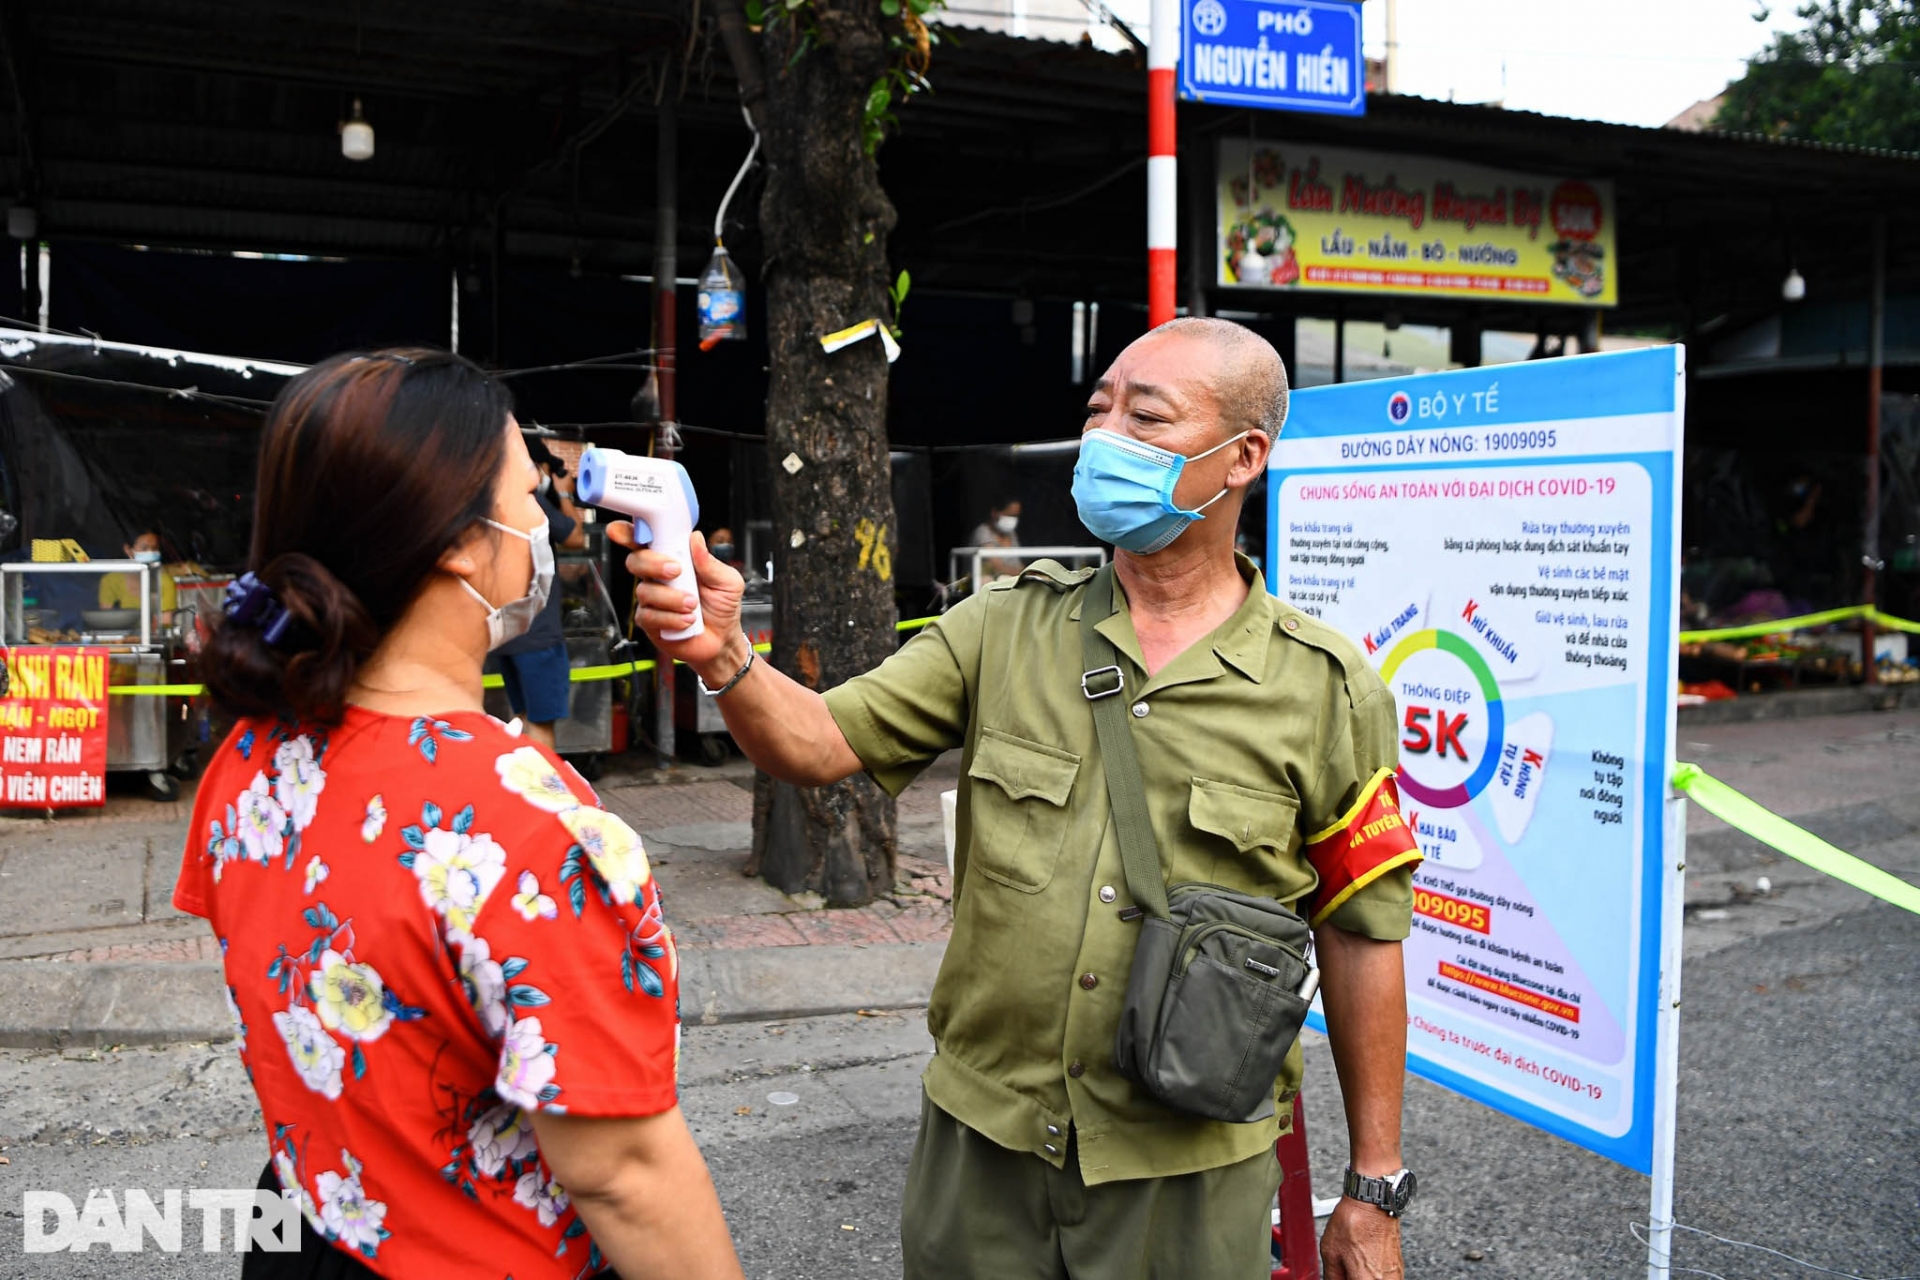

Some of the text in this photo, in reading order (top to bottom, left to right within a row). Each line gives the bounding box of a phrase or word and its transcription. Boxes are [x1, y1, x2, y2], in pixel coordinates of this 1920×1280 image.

[1257, 7, 1313, 36] PHỐ
[1418, 381, 1499, 420] BỘ Y TẾ
[1341, 430, 1557, 459] ĐƯỜNG DÂY NÓNG: 19009095
[1300, 476, 1616, 501] CHUNG SỐNG AN TOÀN VỚI ĐẠI DỊCH COVID-19
[1542, 522, 1558, 536] tay
[1614, 542, 1630, 556] tay
[6, 647, 104, 700] ÁNH RÁN
[1402, 683, 1471, 704] THÔNG ĐIỆP
[48, 706, 99, 733] NGỌT
[1402, 706, 1469, 761] 5K
[3, 732, 82, 764] NEM RÁN
[7, 771, 46, 801] VIÊN
[1362, 812, 1403, 839] TUYÊN
[1449, 1029, 1459, 1044] ta
[1514, 1054, 1540, 1076] dịch
[1542, 1066, 1602, 1100] COVID-19
